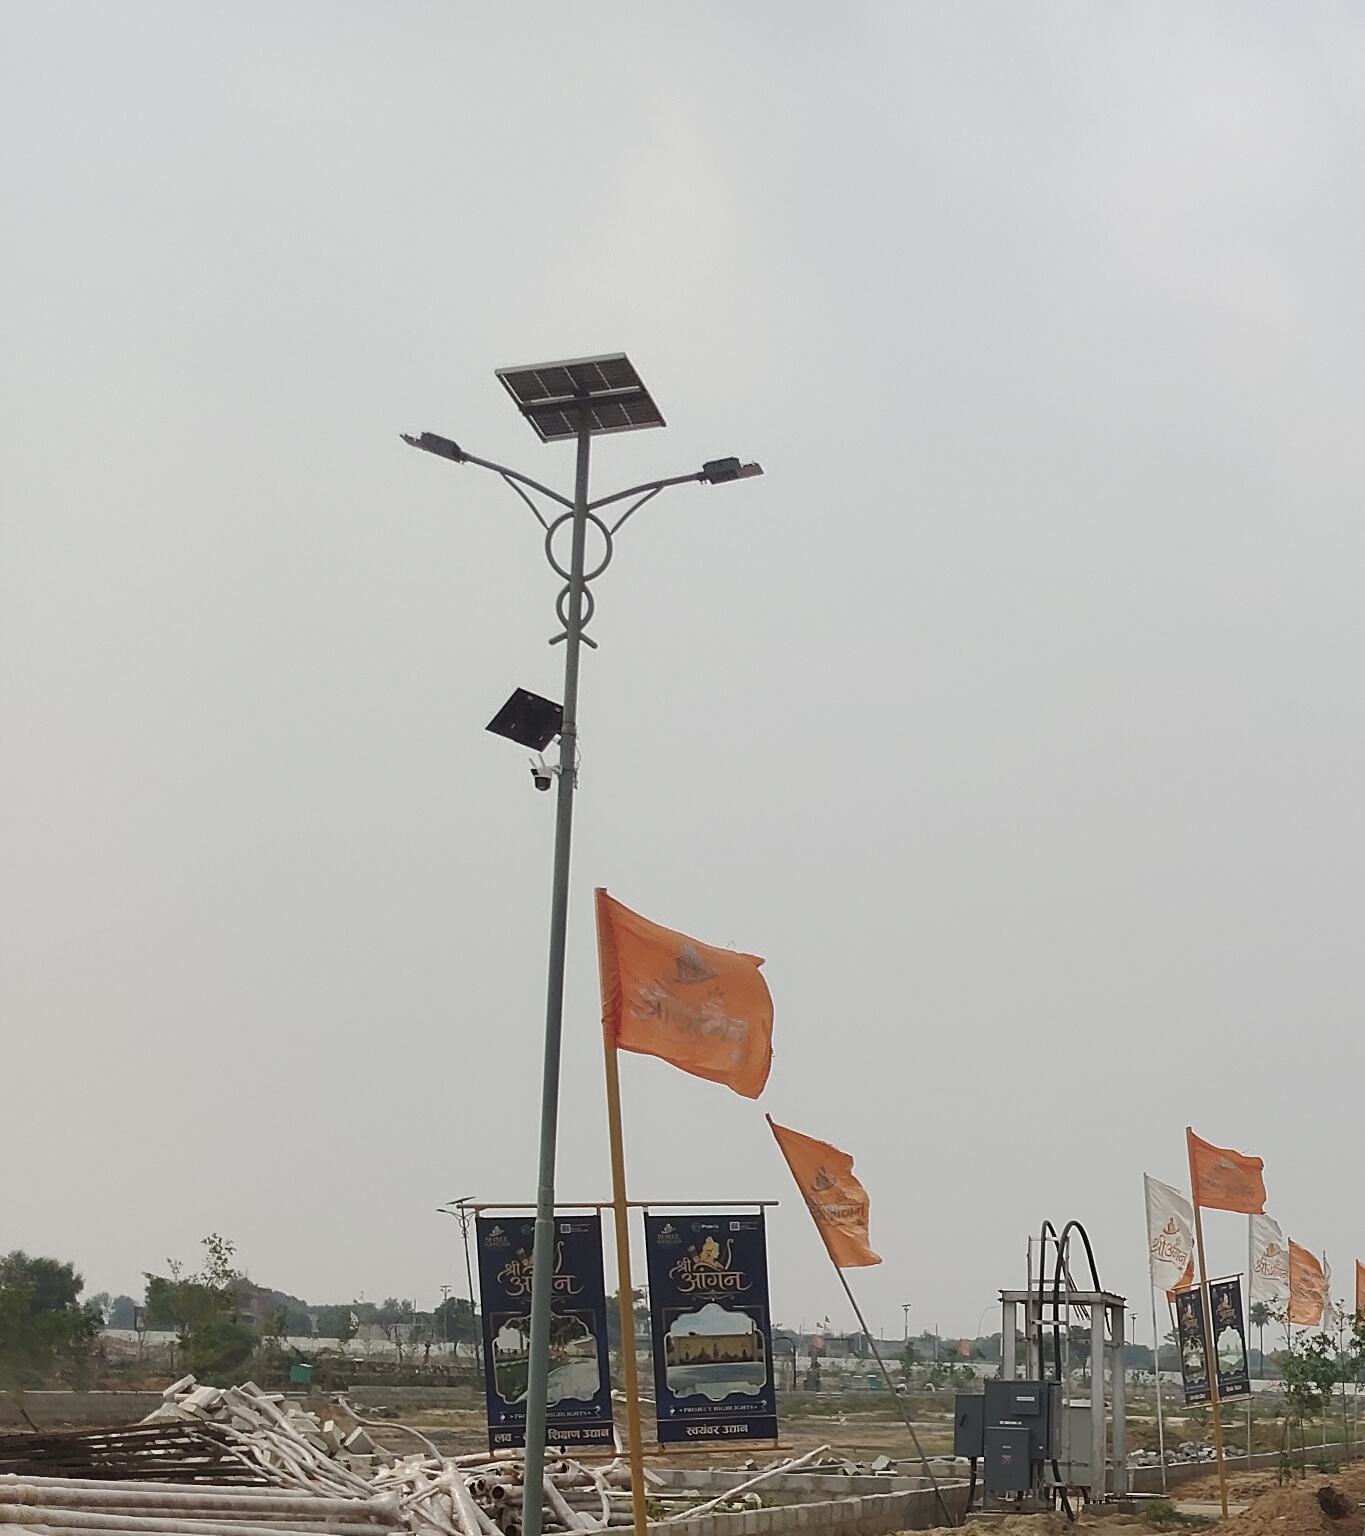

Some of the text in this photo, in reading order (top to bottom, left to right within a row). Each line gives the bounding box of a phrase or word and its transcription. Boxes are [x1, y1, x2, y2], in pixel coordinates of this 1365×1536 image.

[497, 1260, 520, 1283] श्री
[669, 1257, 692, 1279] श्री
[677, 1267, 753, 1292] आंगन
[505, 1269, 584, 1296] आंन
[685, 1424, 721, 1436] स्वयंवर
